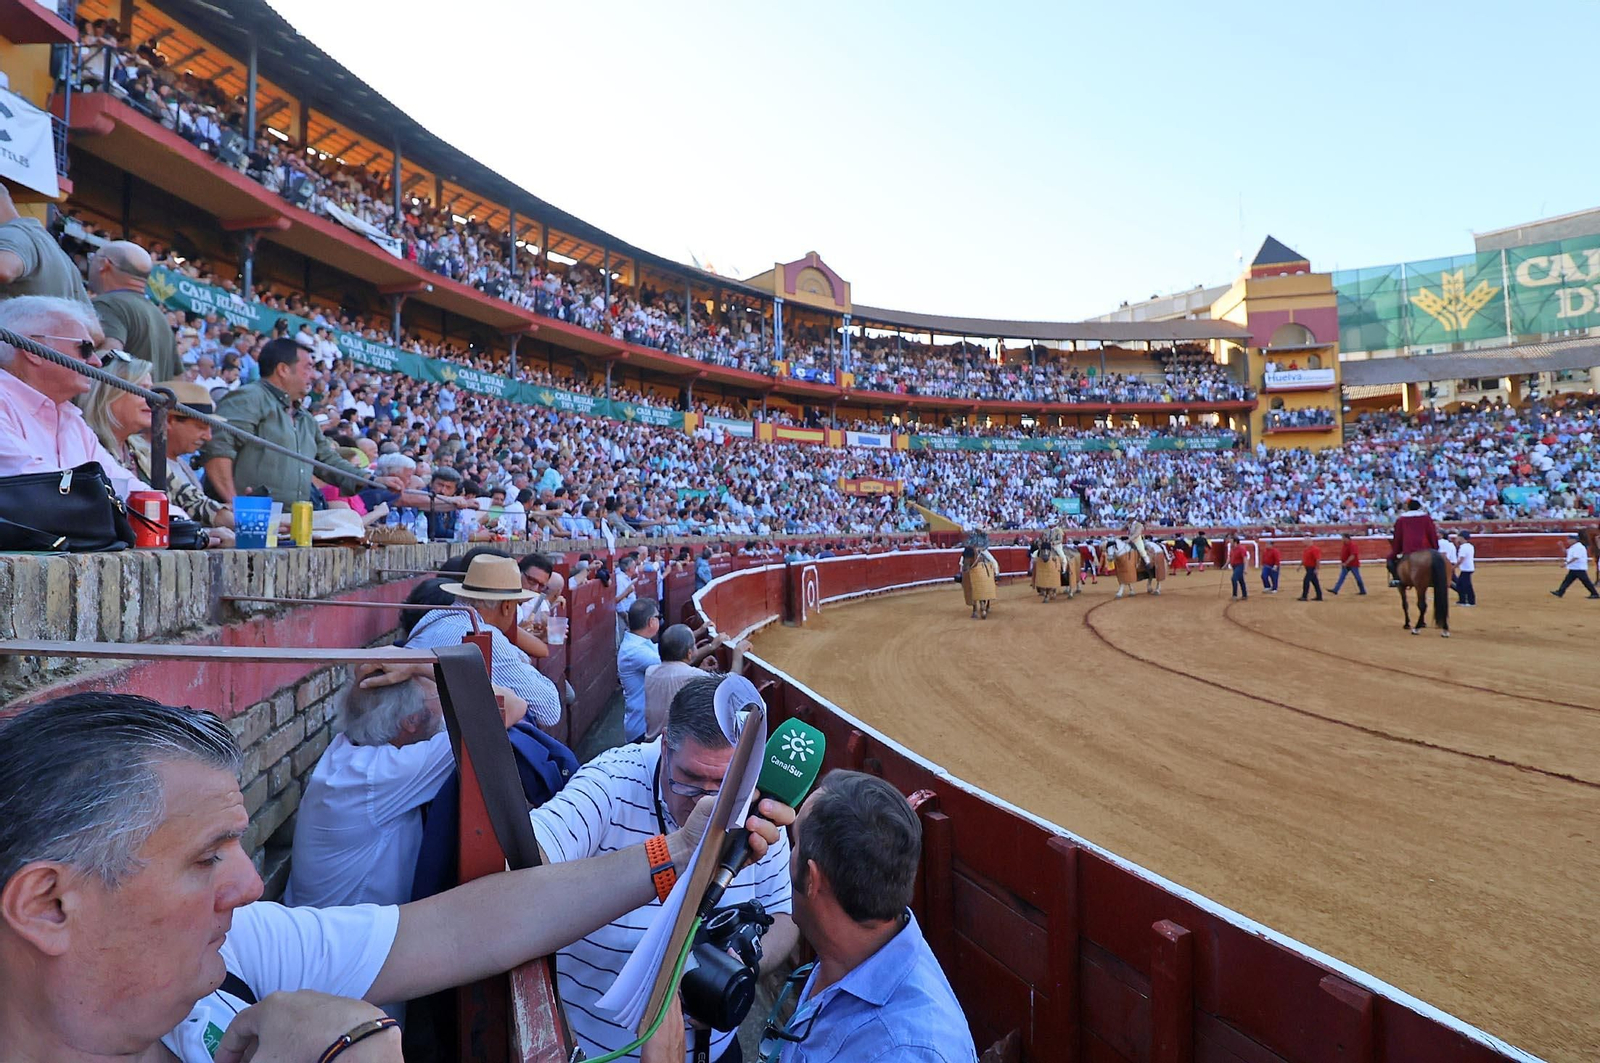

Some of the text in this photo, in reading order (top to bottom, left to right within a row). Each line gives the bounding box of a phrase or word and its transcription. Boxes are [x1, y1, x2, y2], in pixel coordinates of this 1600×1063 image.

[179, 281, 261, 321] CAJA RURAL
[341, 335, 399, 362] CAJA RURAL
[349, 349, 392, 371] DEL SUR
[459, 369, 506, 389] CAJA RURAL
[1268, 373, 1302, 382] Huelva
[466, 380, 502, 397] DEL SUR
[555, 392, 572, 402] CAJA
